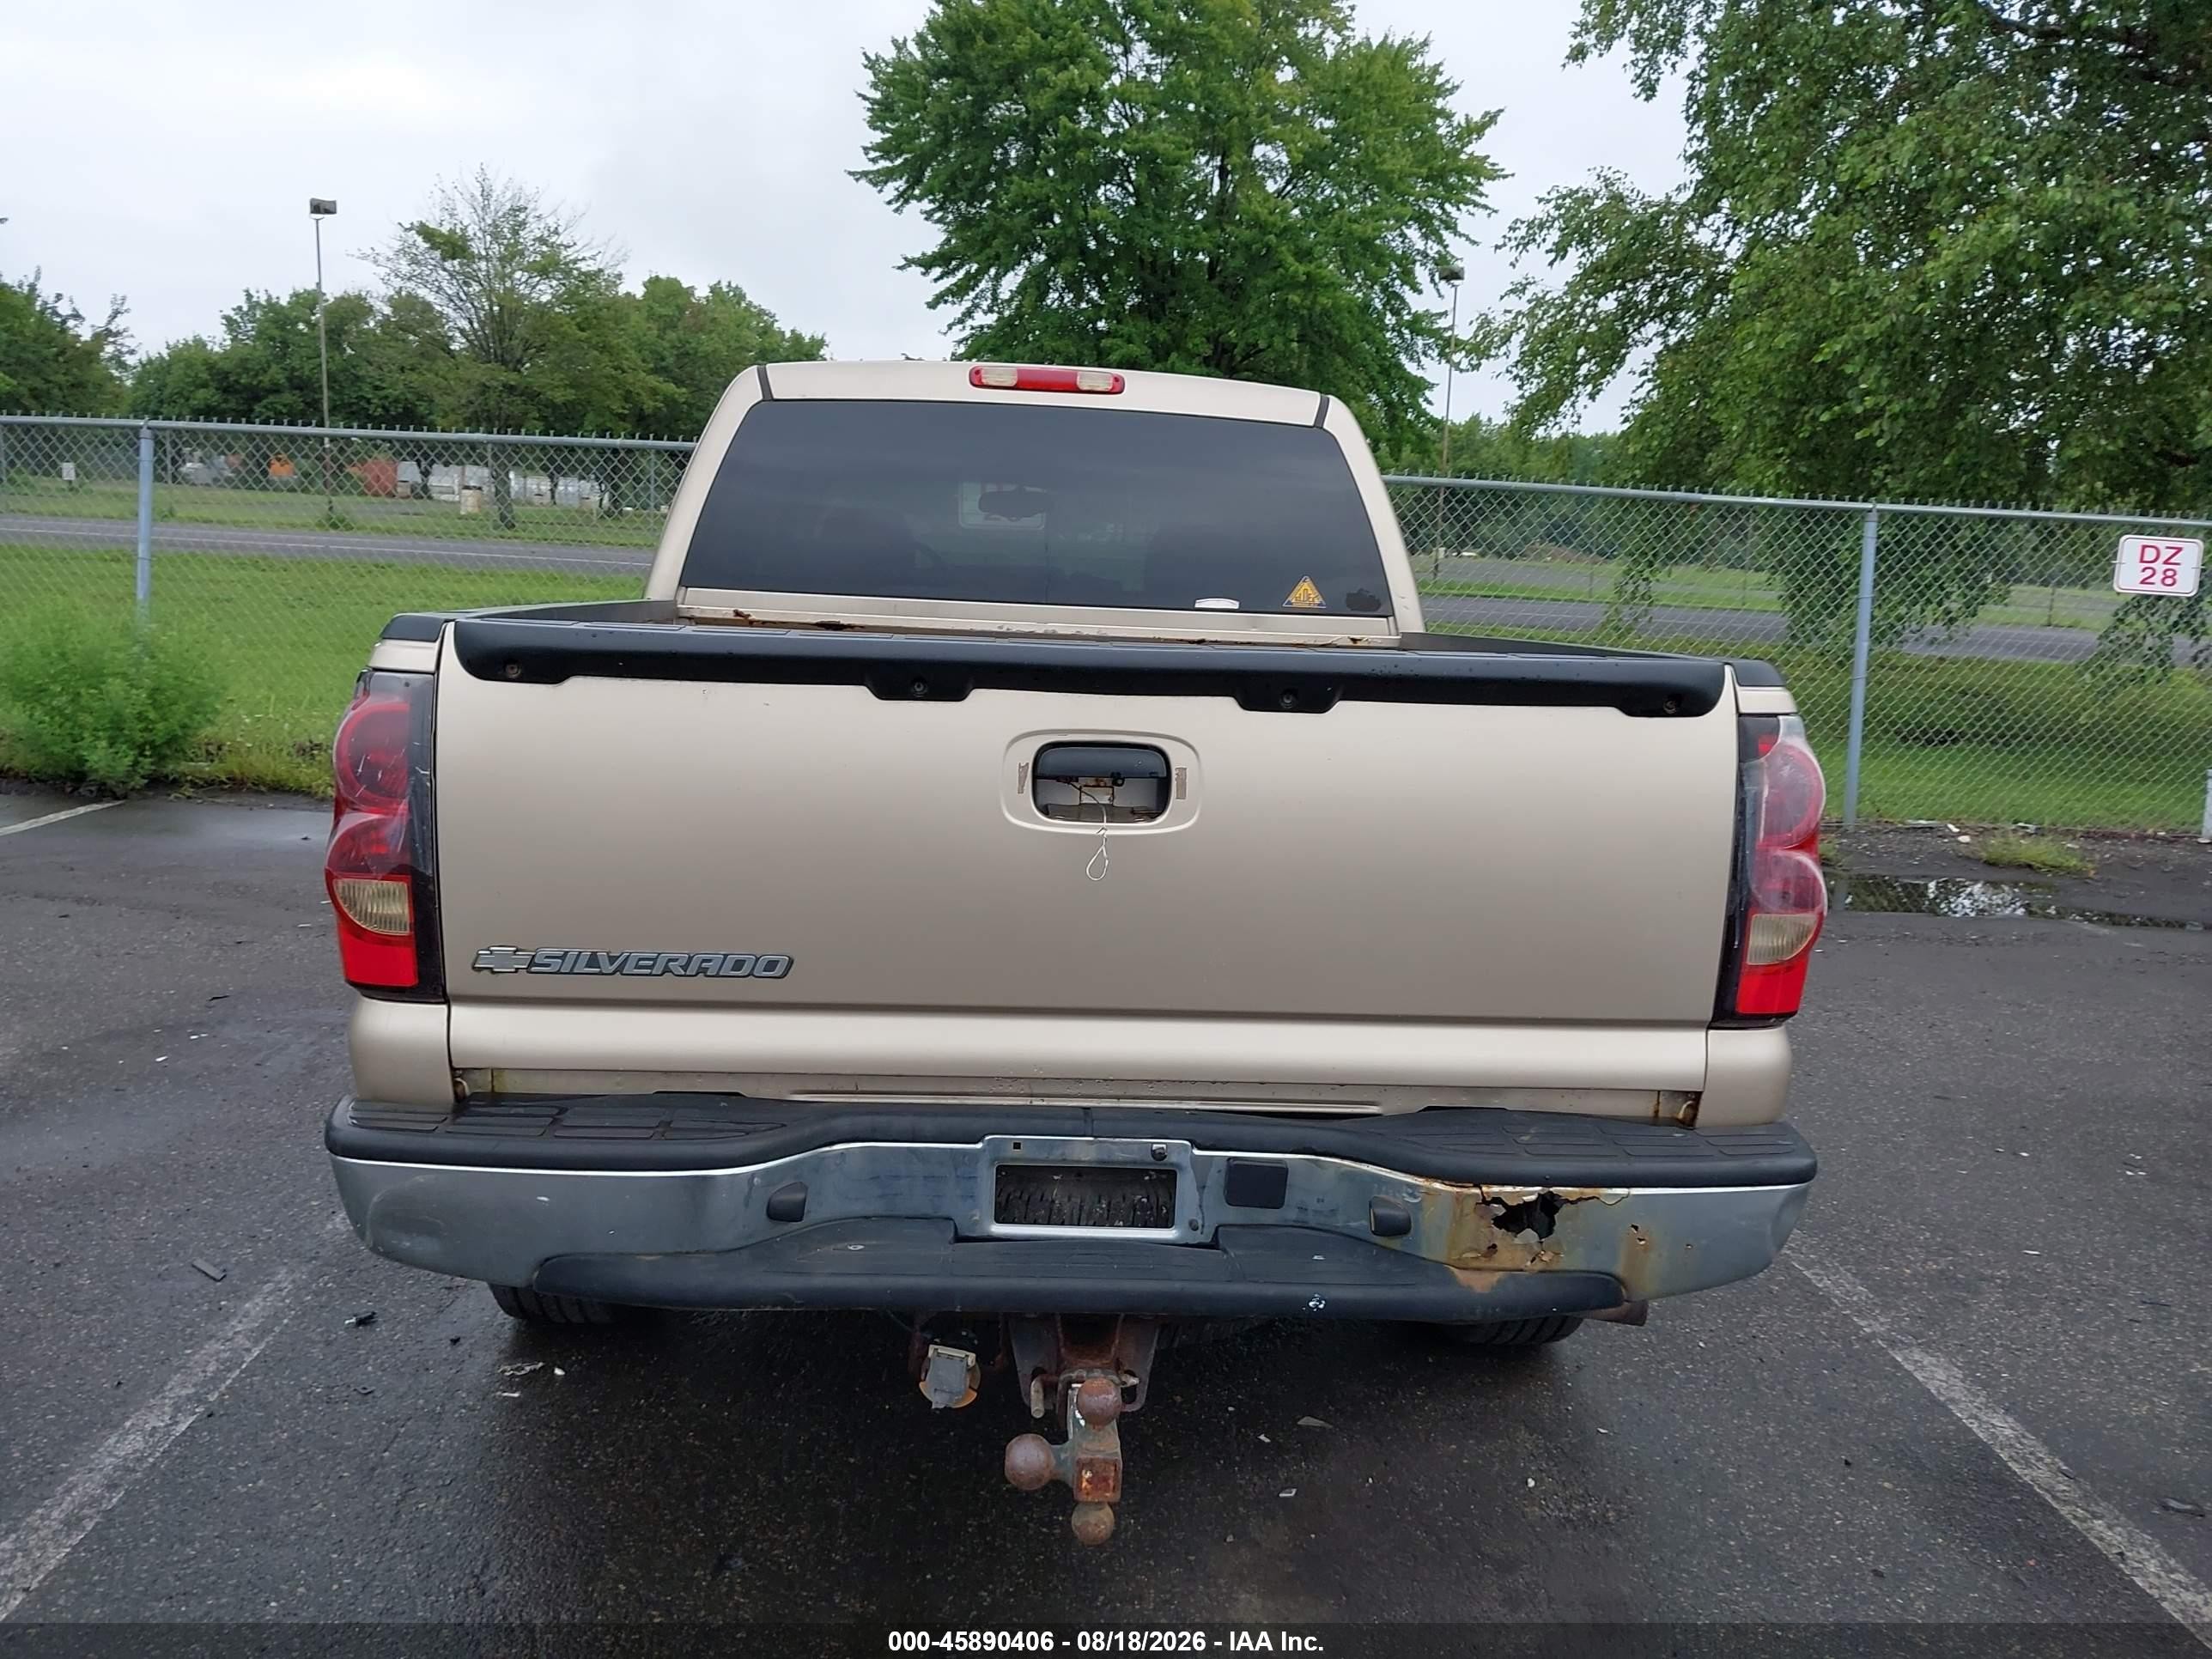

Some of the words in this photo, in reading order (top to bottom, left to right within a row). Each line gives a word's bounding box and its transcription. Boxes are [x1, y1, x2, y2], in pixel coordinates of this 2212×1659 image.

[2139, 544, 2184, 566] DZ
[2139, 567, 2178, 587] 28
[527, 949, 794, 978] SILVERADO
